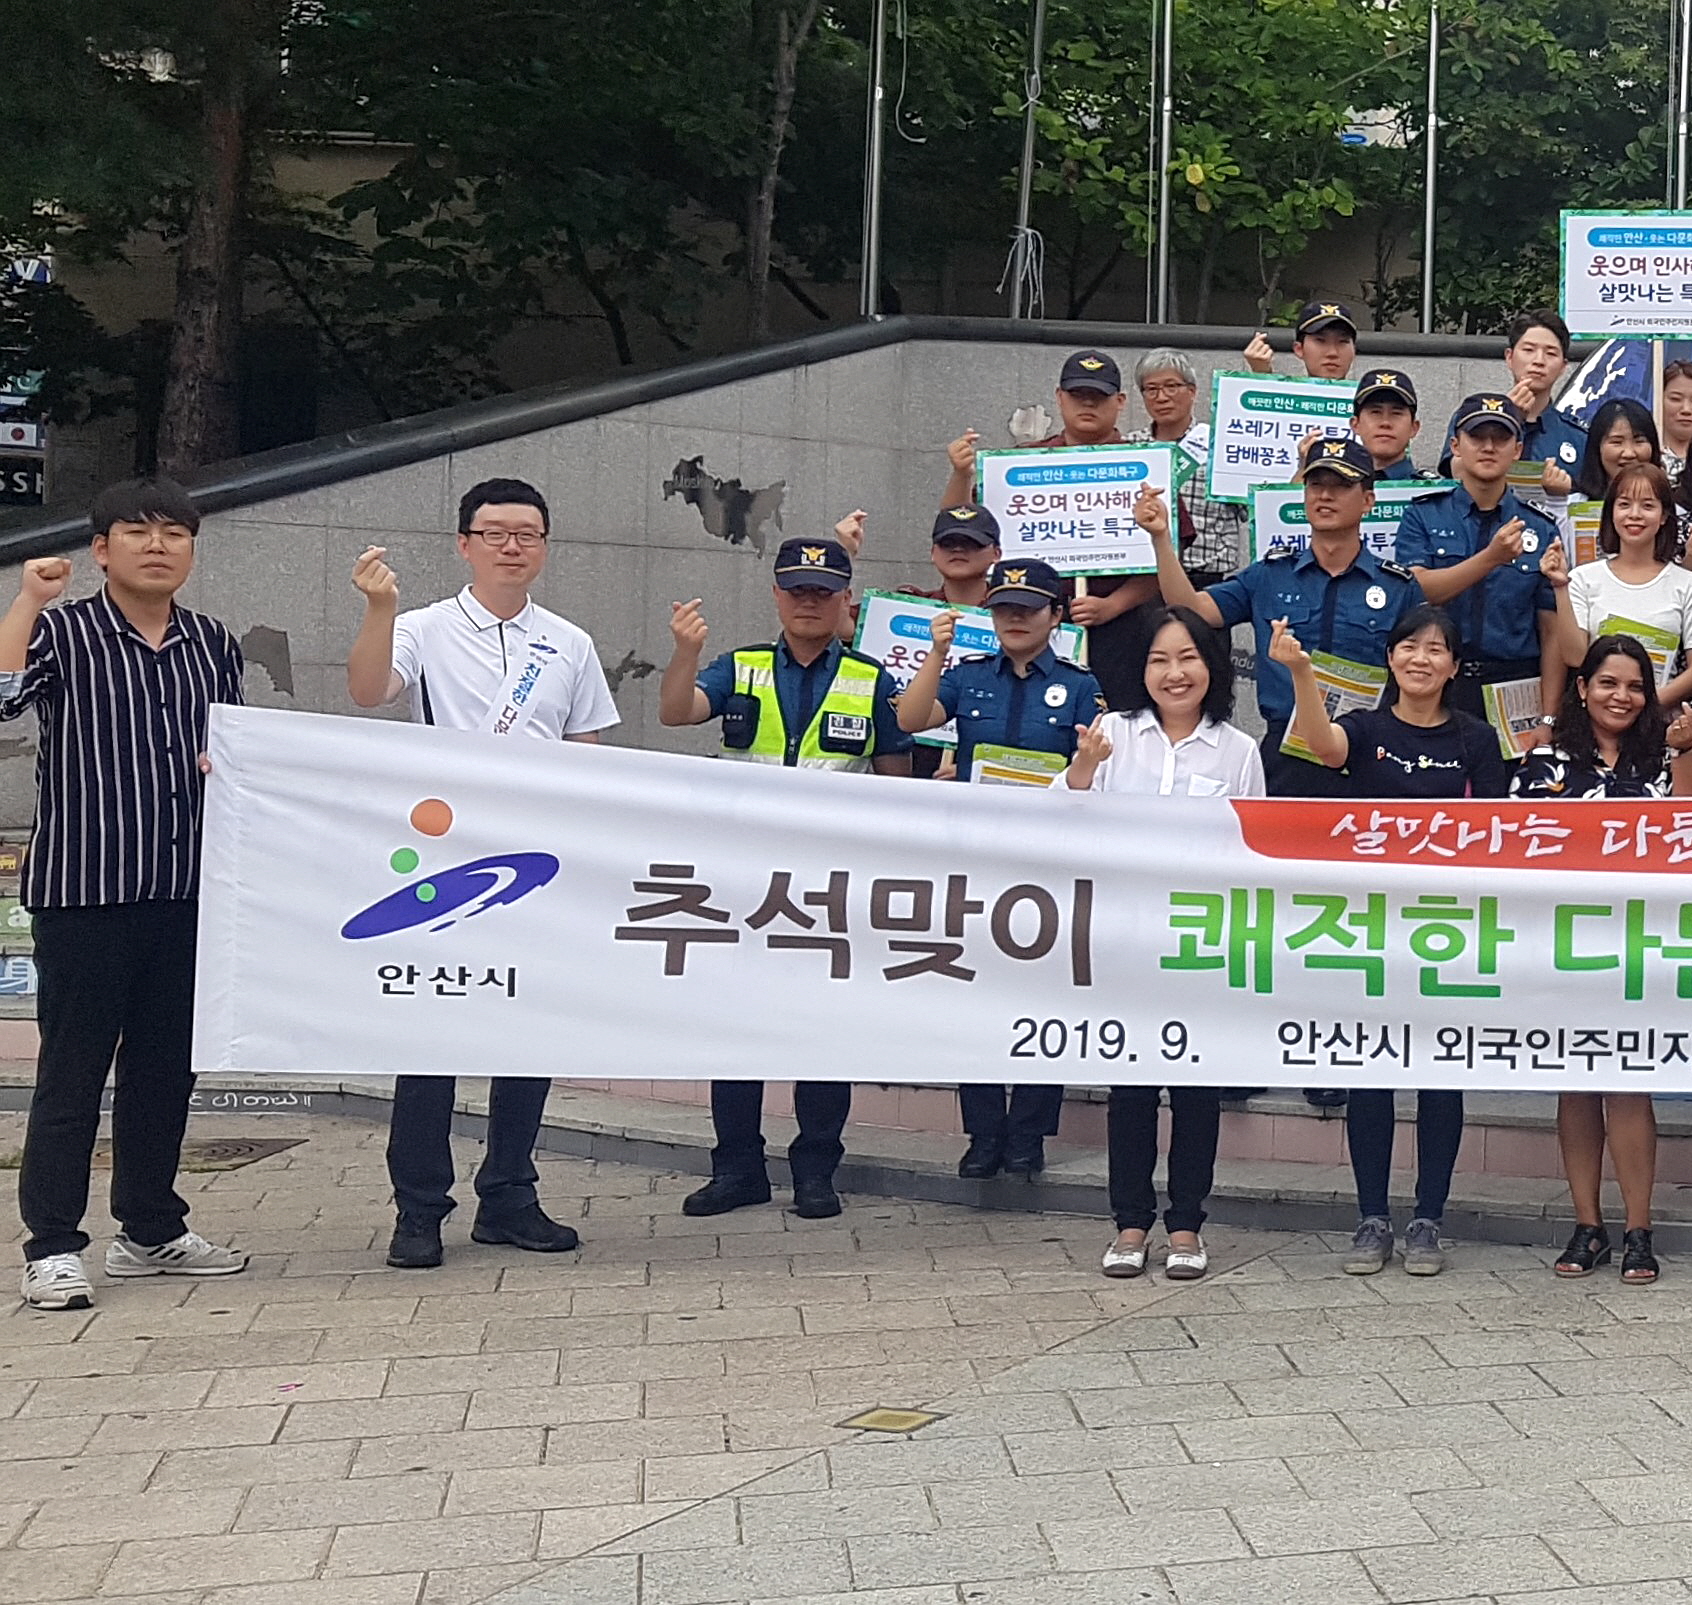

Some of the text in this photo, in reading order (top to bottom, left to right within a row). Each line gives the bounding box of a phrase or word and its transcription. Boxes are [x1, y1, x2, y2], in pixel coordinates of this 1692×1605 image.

[1587, 255, 1647, 277] 웃으며
[1599, 283, 1674, 303] 살맛나는
[1274, 397, 1295, 410] 안산
[1226, 417, 1280, 439] 쓰레기
[1226, 444, 1291, 467] 담배꽁초
[1043, 469, 1064, 481] 안산
[1006, 493, 1067, 516] 웃으며
[1018, 516, 1139, 542] 살맛나는 특구
[1269, 533, 1311, 551] 쓰레
[832, 729, 863, 737] POLICE
[1330, 806, 1570, 860] 살맛나는
[614, 863, 1094, 987] 추석맞이
[1159, 887, 1515, 1000] 쾌적한
[377, 964, 517, 998] 안산시
[1010, 1018, 1138, 1063] 2019.
[1160, 1020, 1200, 1064] 9.
[1277, 1020, 1411, 1068] 안산시
